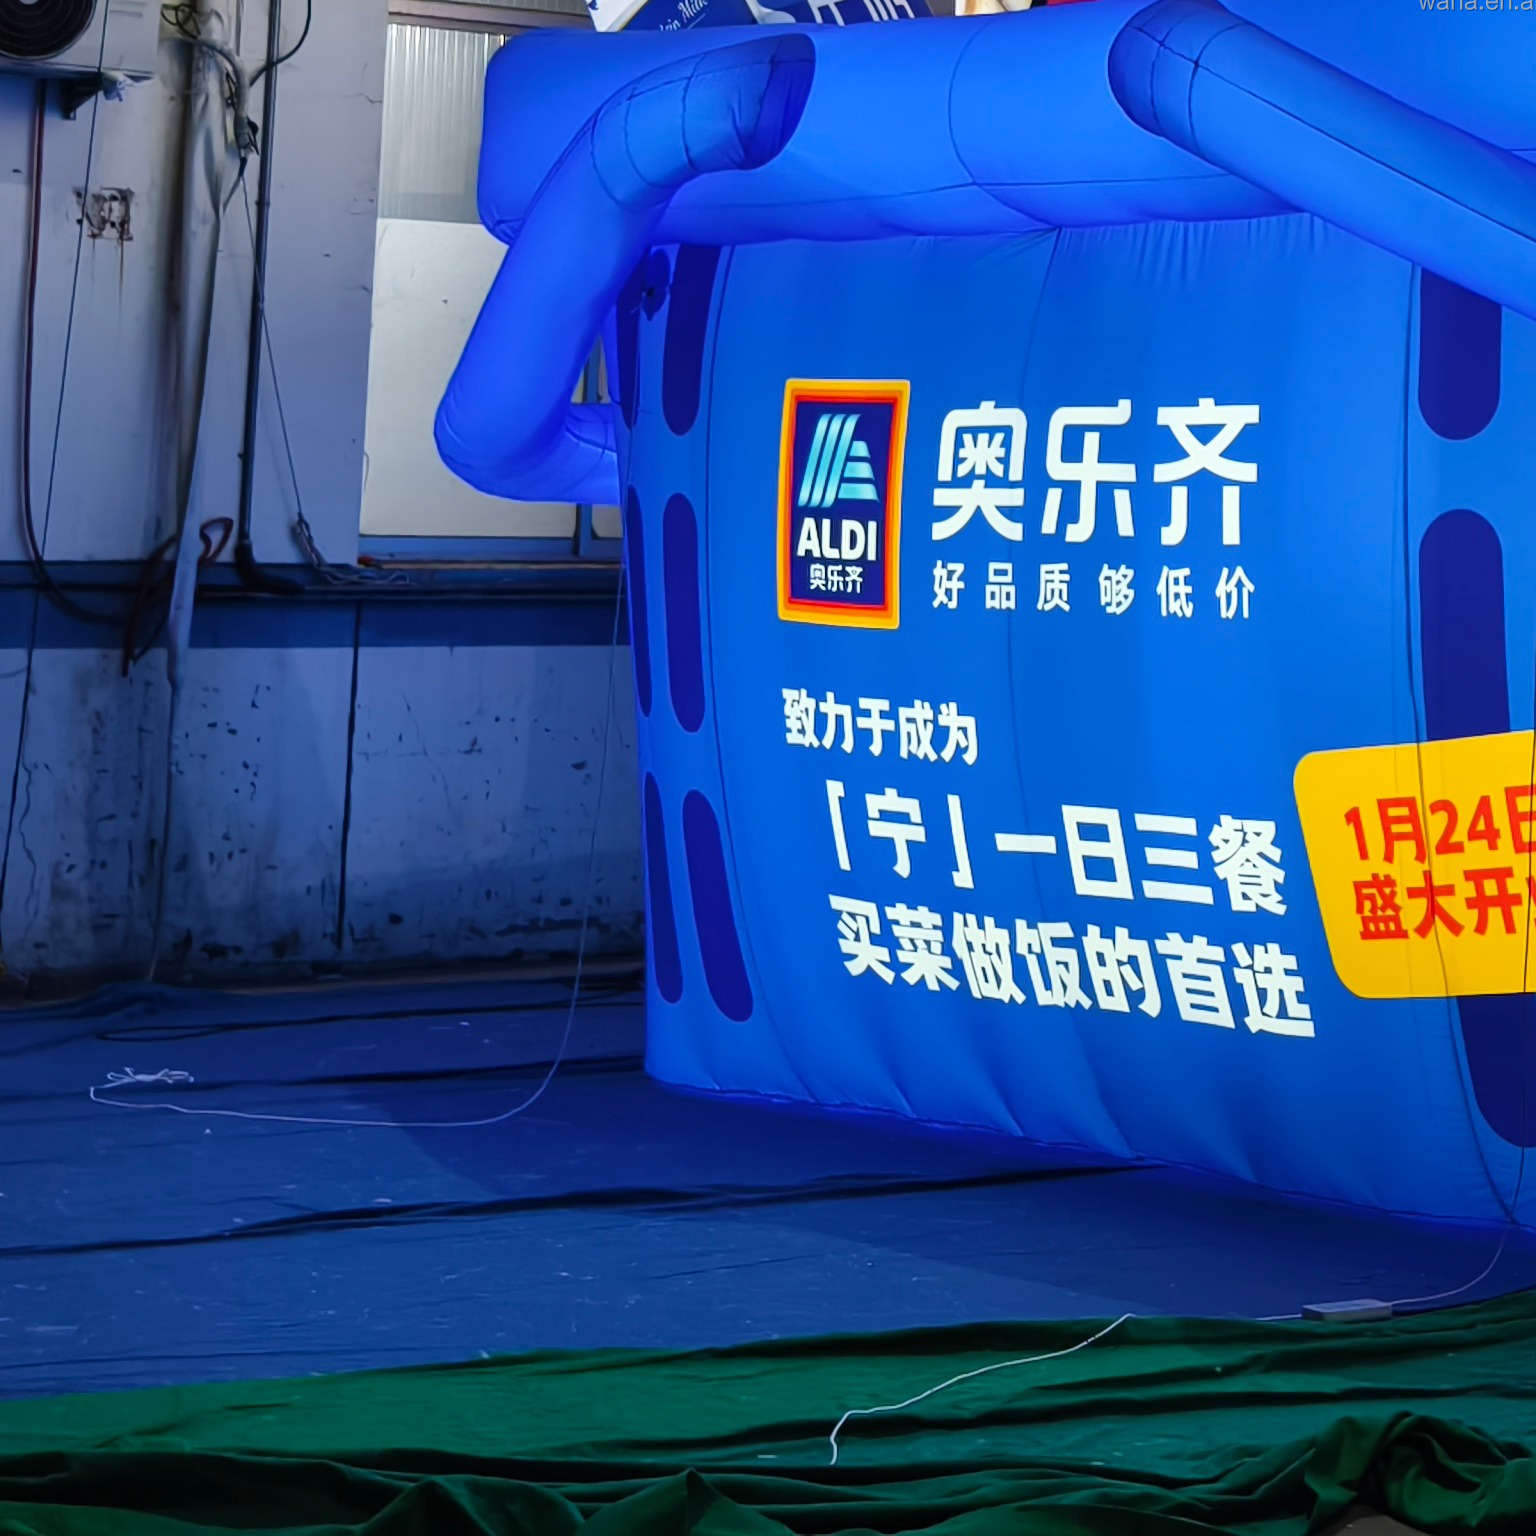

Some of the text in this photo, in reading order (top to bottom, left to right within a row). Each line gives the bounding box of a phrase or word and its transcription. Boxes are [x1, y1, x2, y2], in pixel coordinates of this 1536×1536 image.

[931, 397, 1261, 547] 奥乐齐
[797, 517, 877, 561] ALDI
[810, 563, 863, 594] 奥乐齐
[932, 560, 1255, 619] 好品质够低价
[781, 688, 979, 766] 致力于成为
[828, 893, 1316, 1037] 买菜做饭的首选
